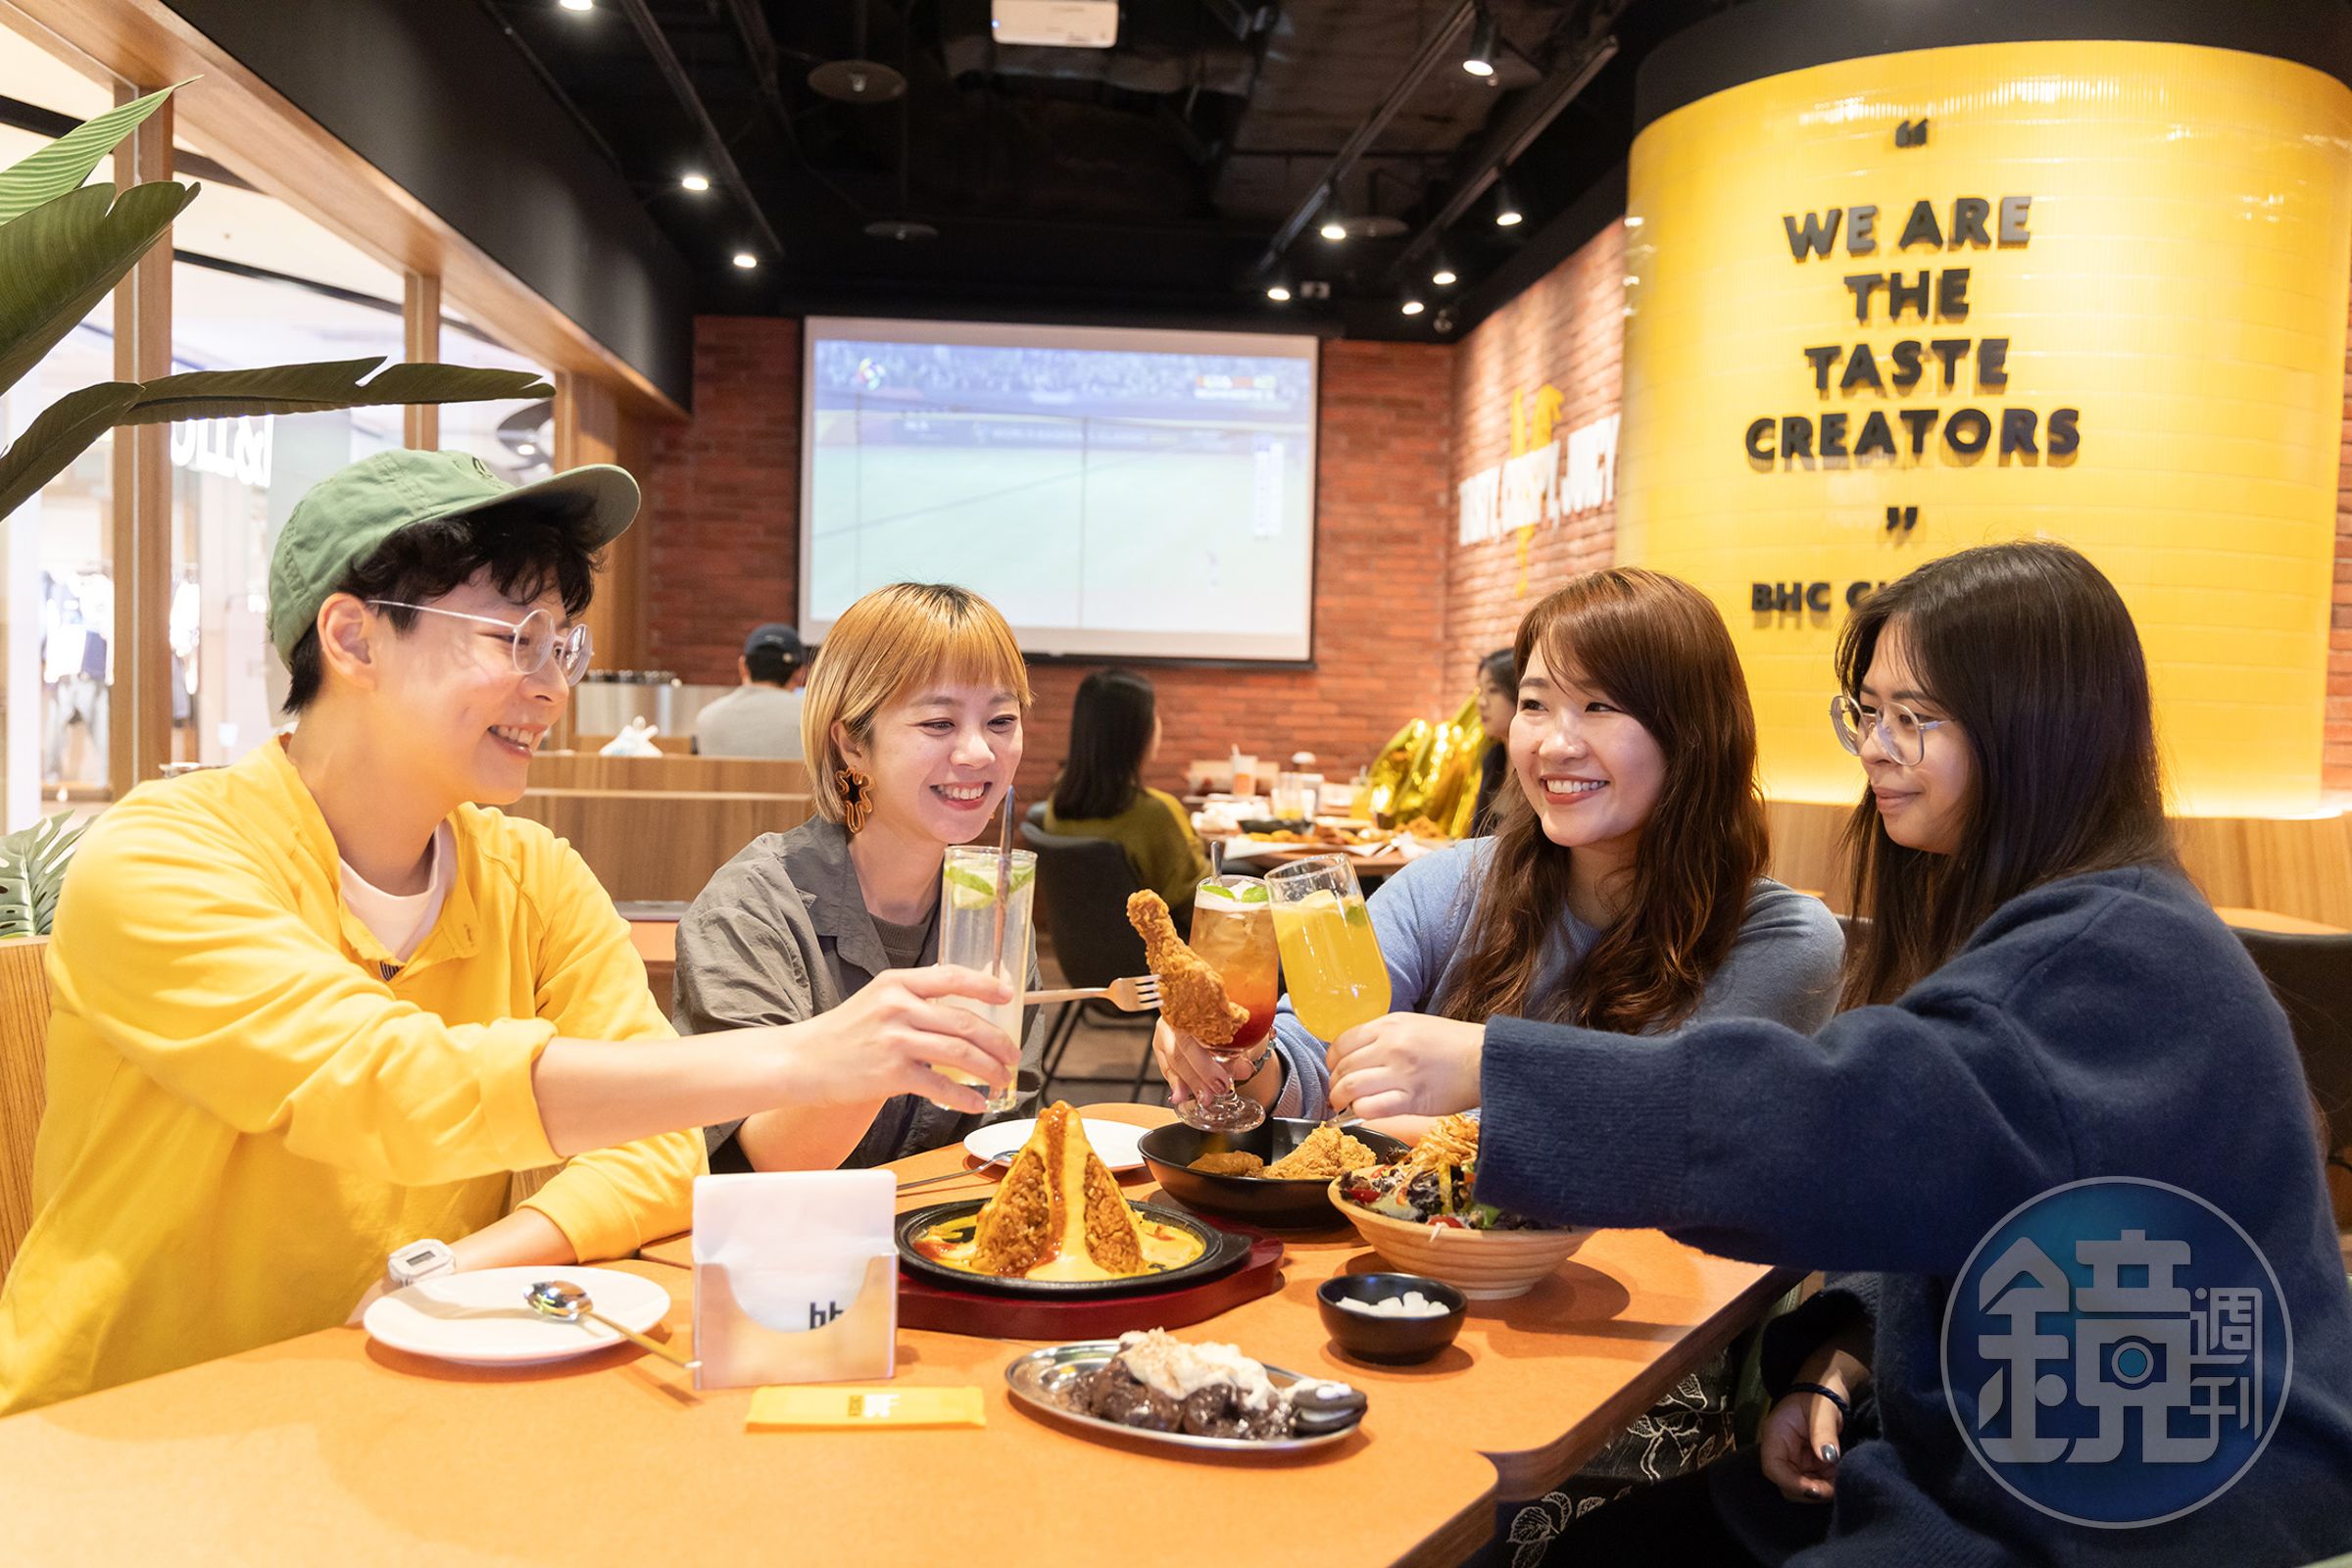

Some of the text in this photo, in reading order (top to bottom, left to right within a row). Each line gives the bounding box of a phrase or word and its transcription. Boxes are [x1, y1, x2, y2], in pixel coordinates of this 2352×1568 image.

[1782, 195, 2033, 261] WE ARE
[1842, 268, 1971, 323] THE
[1803, 337, 2010, 392] TASTE
[1743, 408, 2082, 459] CREATORS
[1751, 581, 1831, 612] BHC
